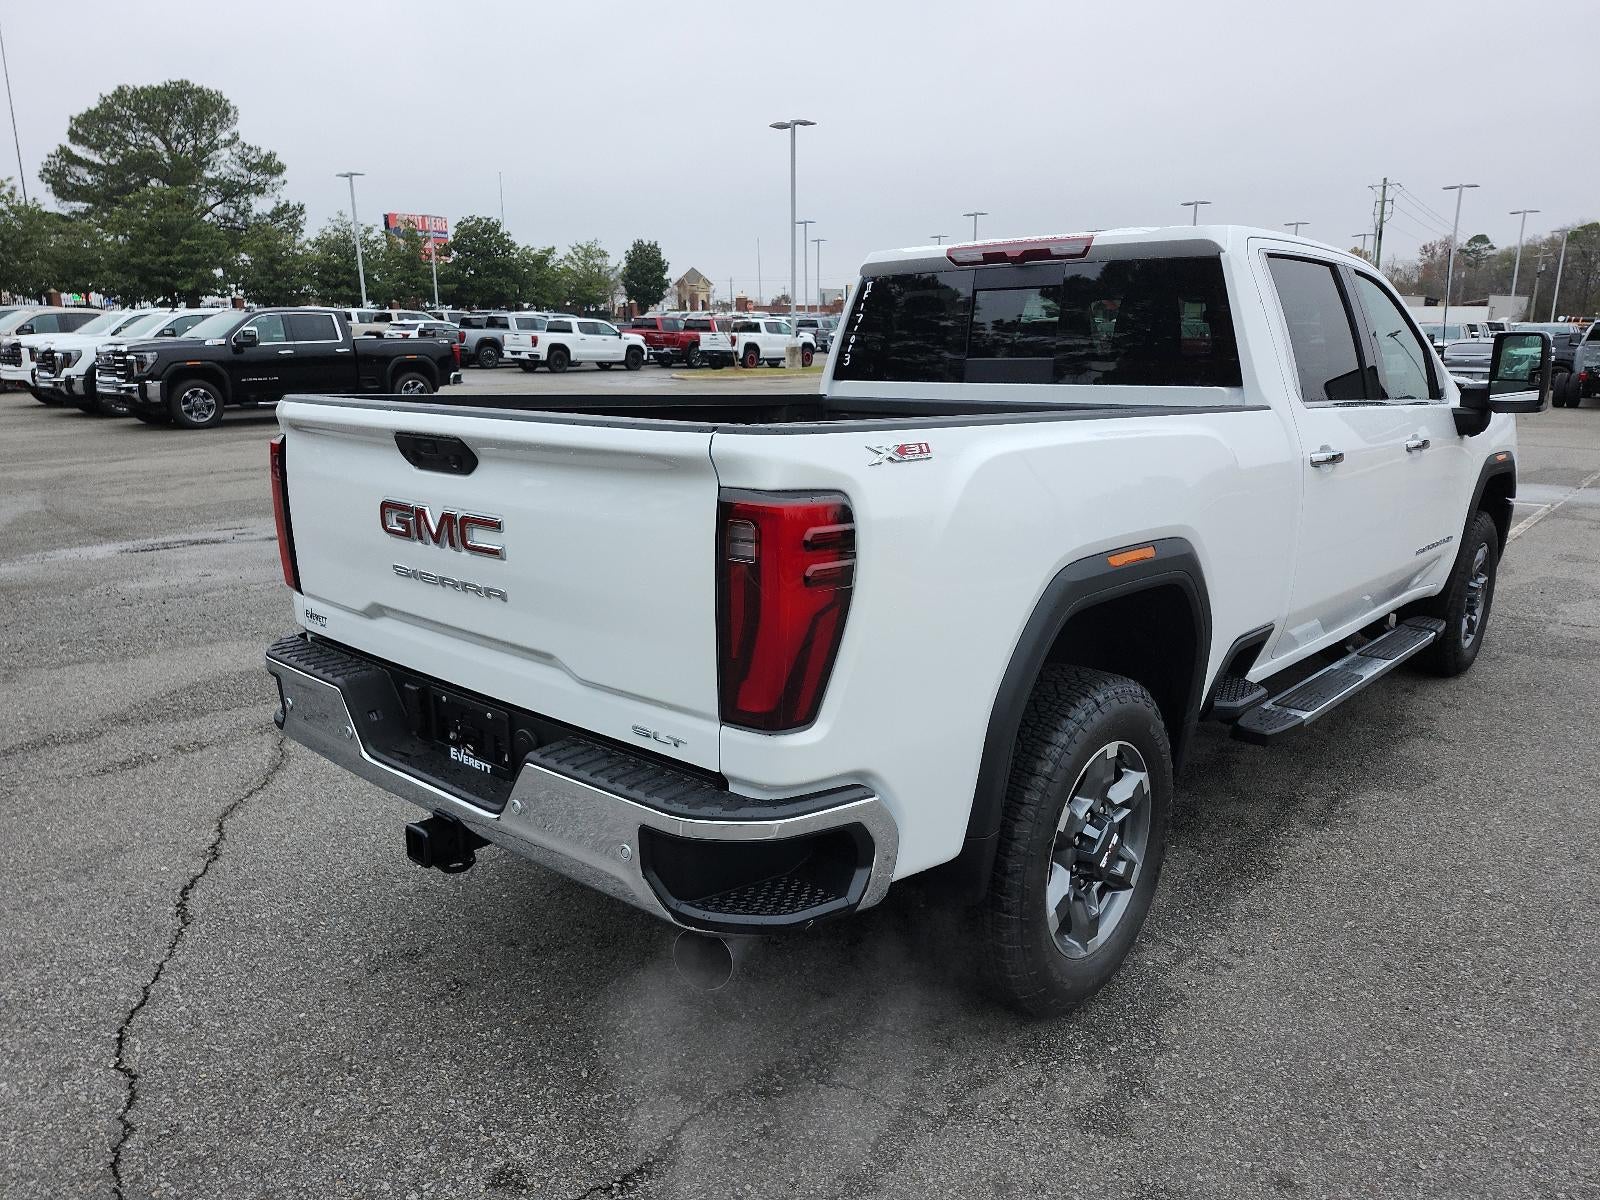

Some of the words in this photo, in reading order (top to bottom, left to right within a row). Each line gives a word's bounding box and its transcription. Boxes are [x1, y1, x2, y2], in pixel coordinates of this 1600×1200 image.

[425, 216, 448, 232] HERE
[380, 498, 507, 561] GMC
[392, 563, 508, 602] SIERRA
[631, 724, 688, 748] SLT
[450, 746, 492, 774] EVERETT
